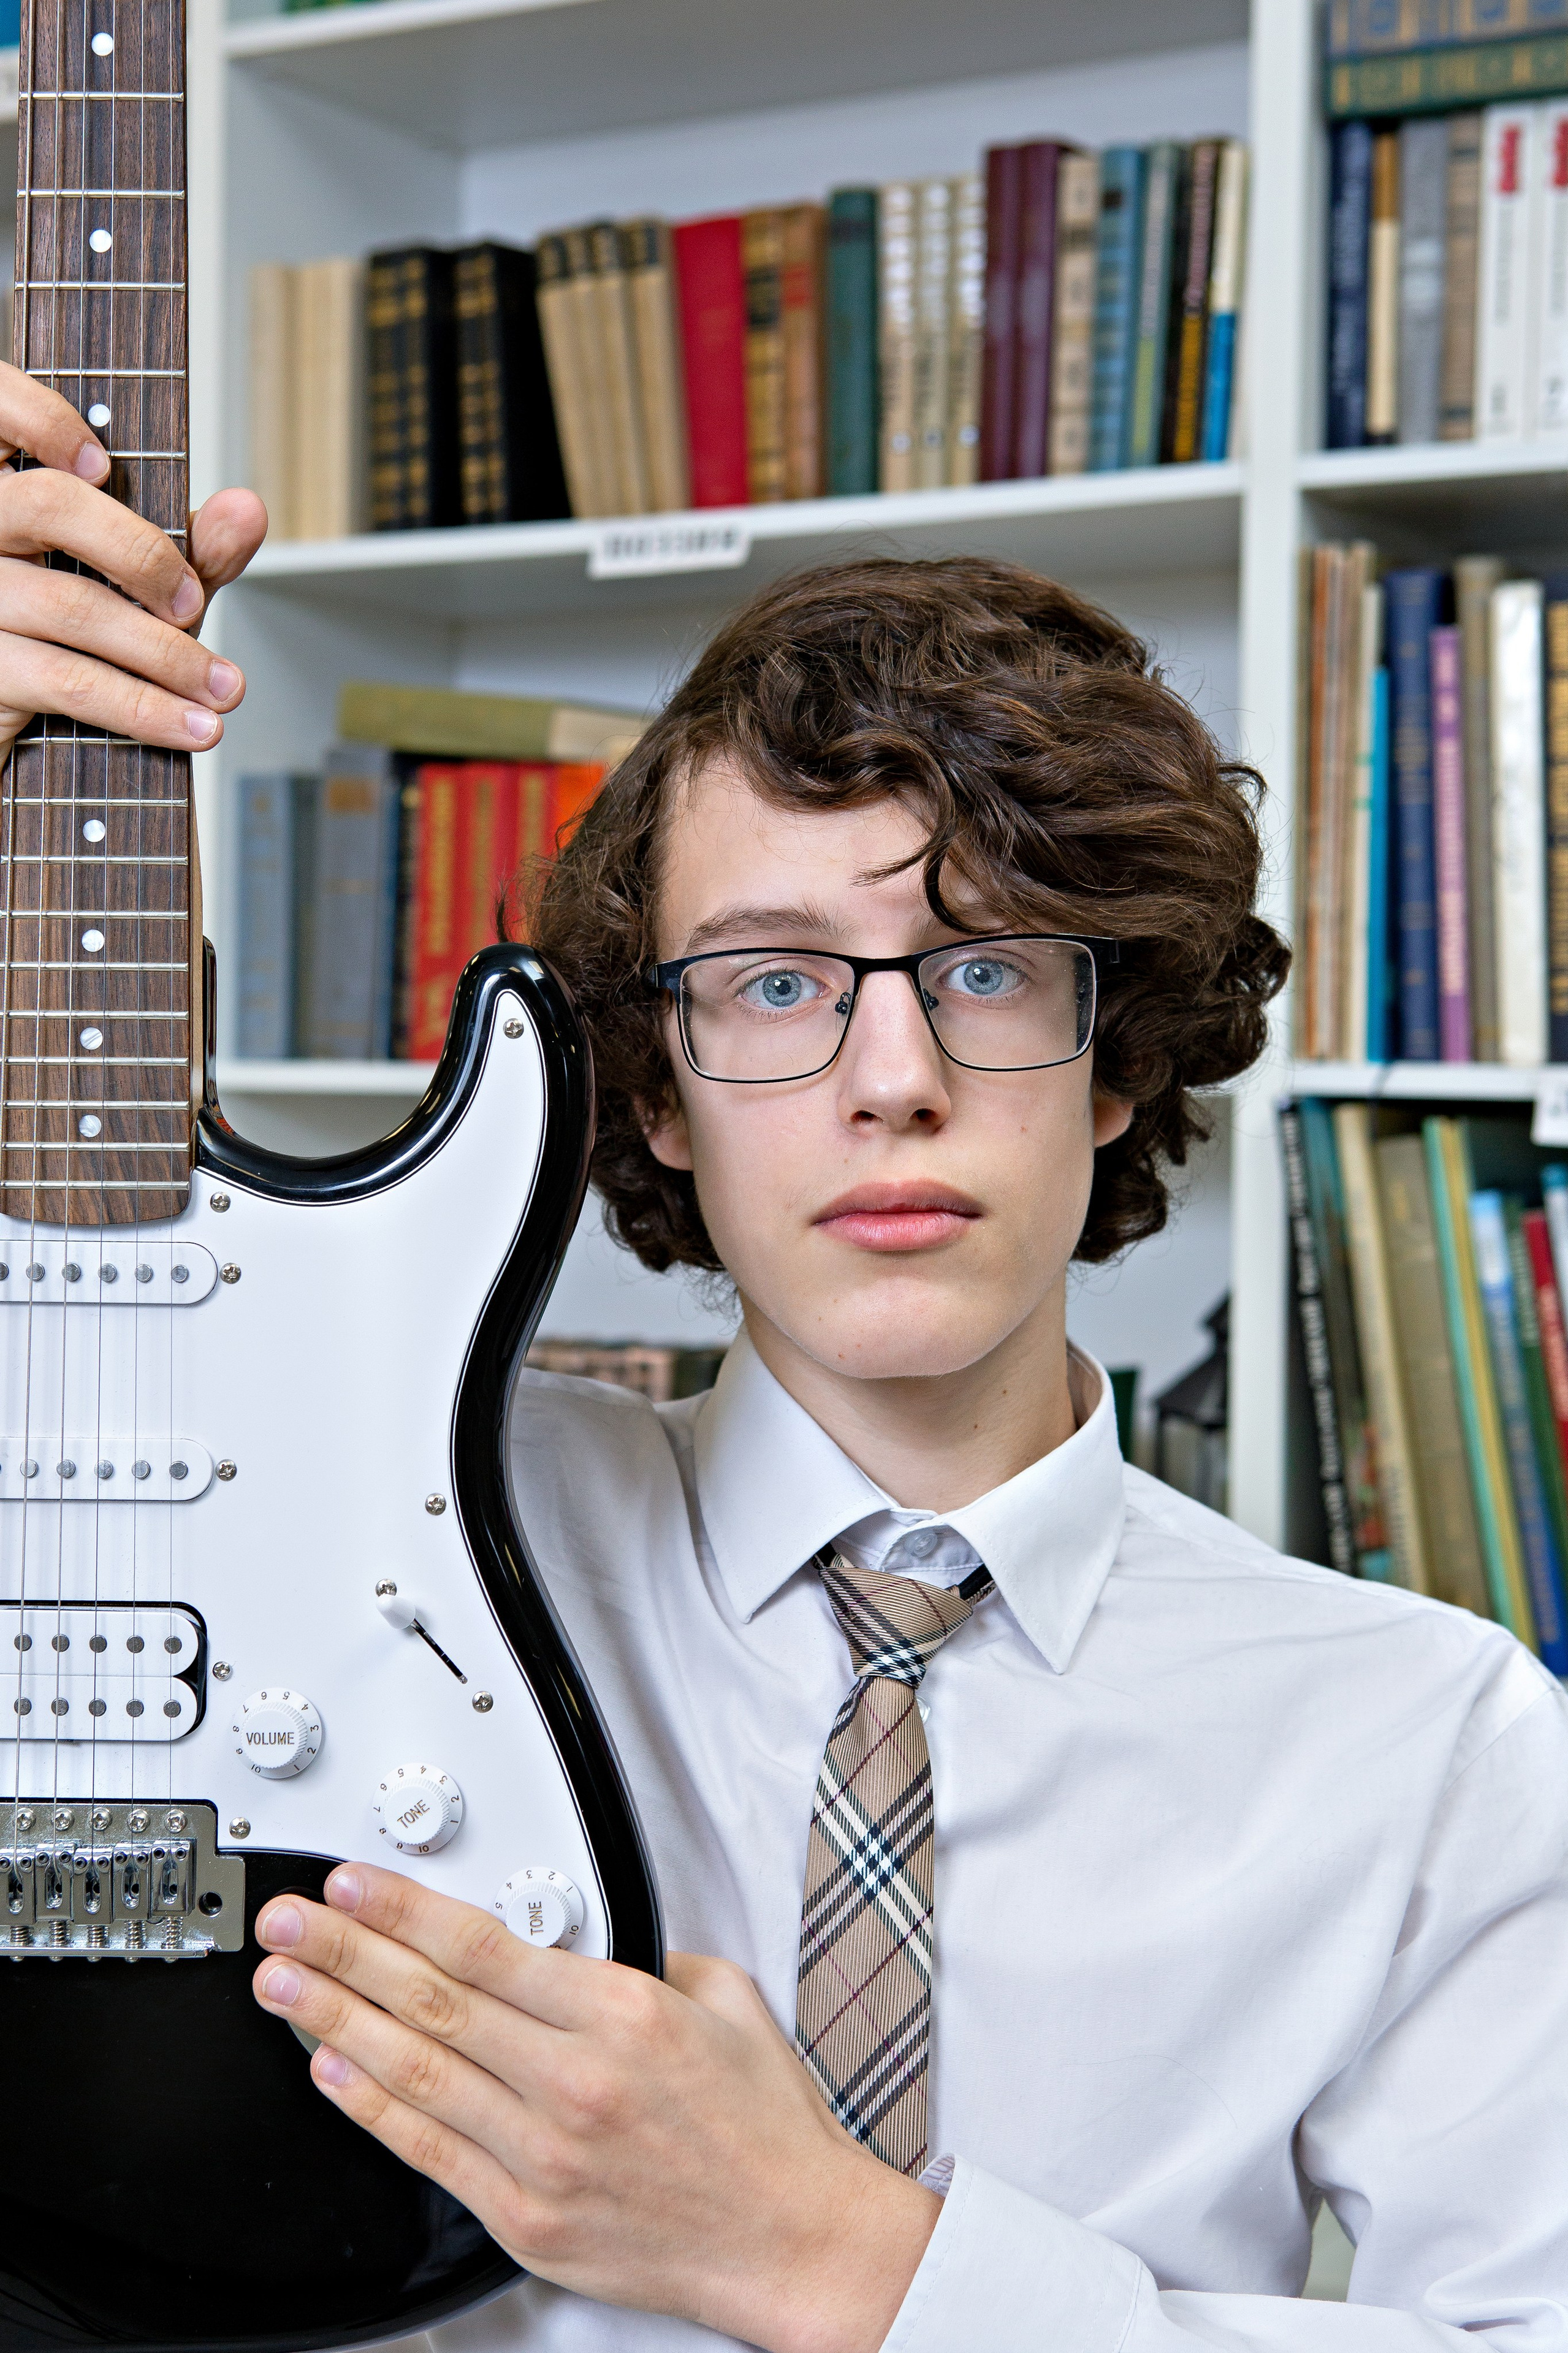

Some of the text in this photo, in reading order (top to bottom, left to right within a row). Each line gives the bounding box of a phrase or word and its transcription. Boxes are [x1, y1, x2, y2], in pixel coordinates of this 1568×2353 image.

[243, 1704, 249, 1713] 7
[251, 1764, 261, 1773] 10
[246, 1732, 295, 1745] VOLUME
[398, 1768, 404, 1777] 5
[421, 1766, 427, 1774] 4
[440, 1775, 447, 1785] 3
[397, 1799, 430, 1829] TONE
[526, 1870, 533, 1878] 3
[548, 1871, 555, 1880] 2
[528, 1901, 544, 1935] TONE
[569, 1925, 579, 1935] 10
